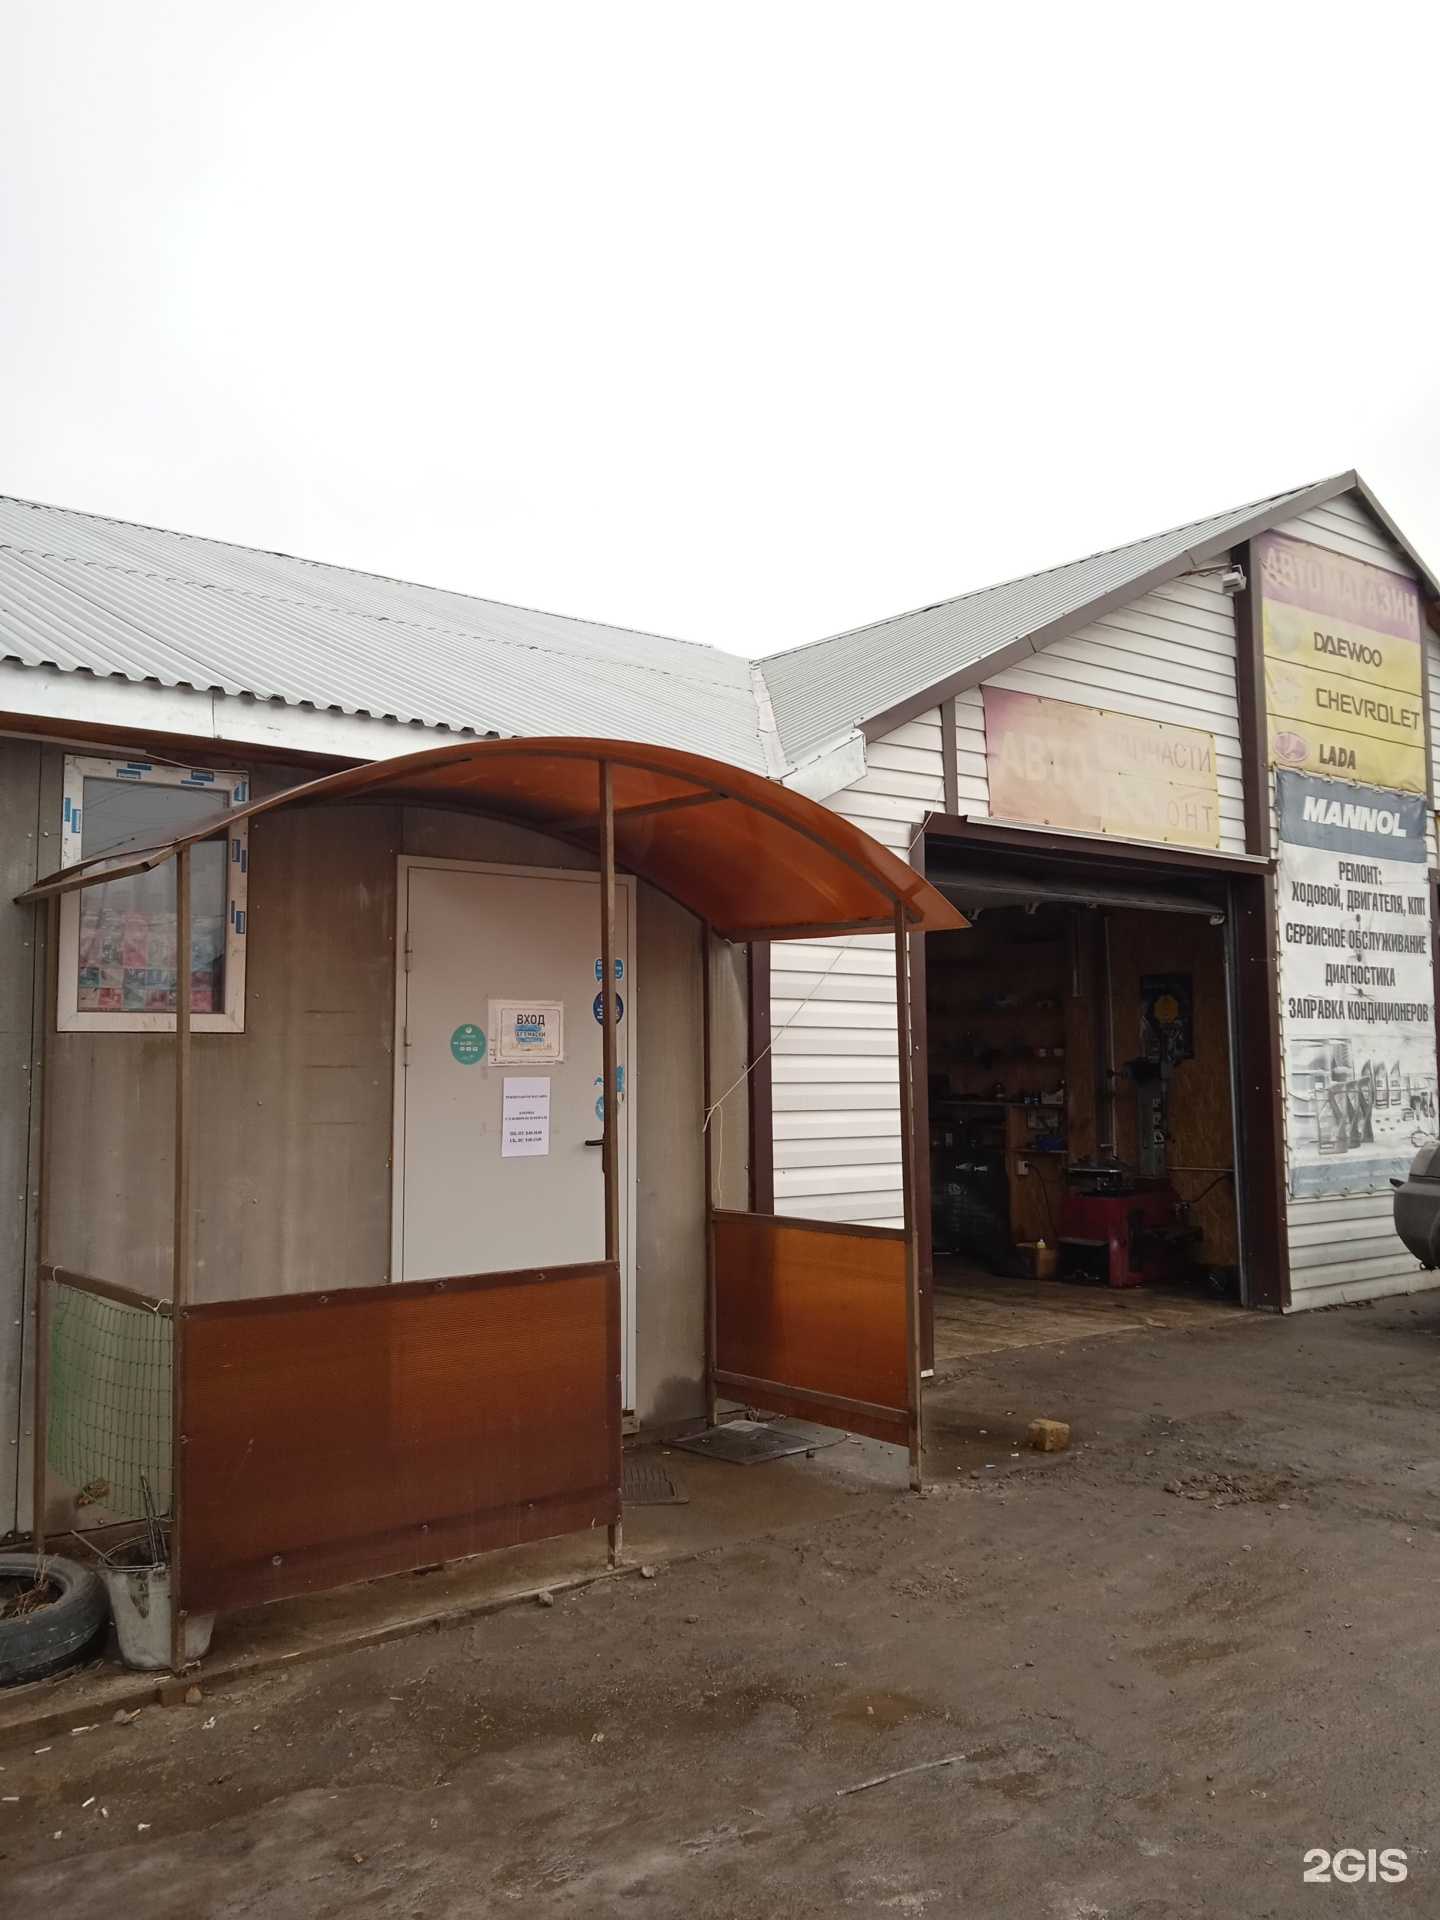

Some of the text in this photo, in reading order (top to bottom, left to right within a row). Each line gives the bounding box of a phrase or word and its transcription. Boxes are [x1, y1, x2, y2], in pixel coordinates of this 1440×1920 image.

[1265, 548, 1417, 624] АВТОМАГАЗИН
[1314, 631, 1382, 667] DAEWOO
[1316, 688, 1420, 730] CHEVROLET
[1319, 743, 1356, 770] LADA
[1303, 795, 1407, 837] MANNOL
[1338, 861, 1383, 885] РЕМОНТ:
[1291, 881, 1426, 916] ХОДОВОЙ, ДВИГАТЕЛЯ, КПП
[1286, 922, 1427, 954] СЕРВИСНОЕ ОБСЛУЖИВАНИЕ
[1325, 963, 1396, 987] ДИАГНОСТИКА
[516, 1013, 545, 1026] ВХОД
[1288, 997, 1429, 1024] ЗАПРАВКА КОНДИЦИОНЕРОВ
